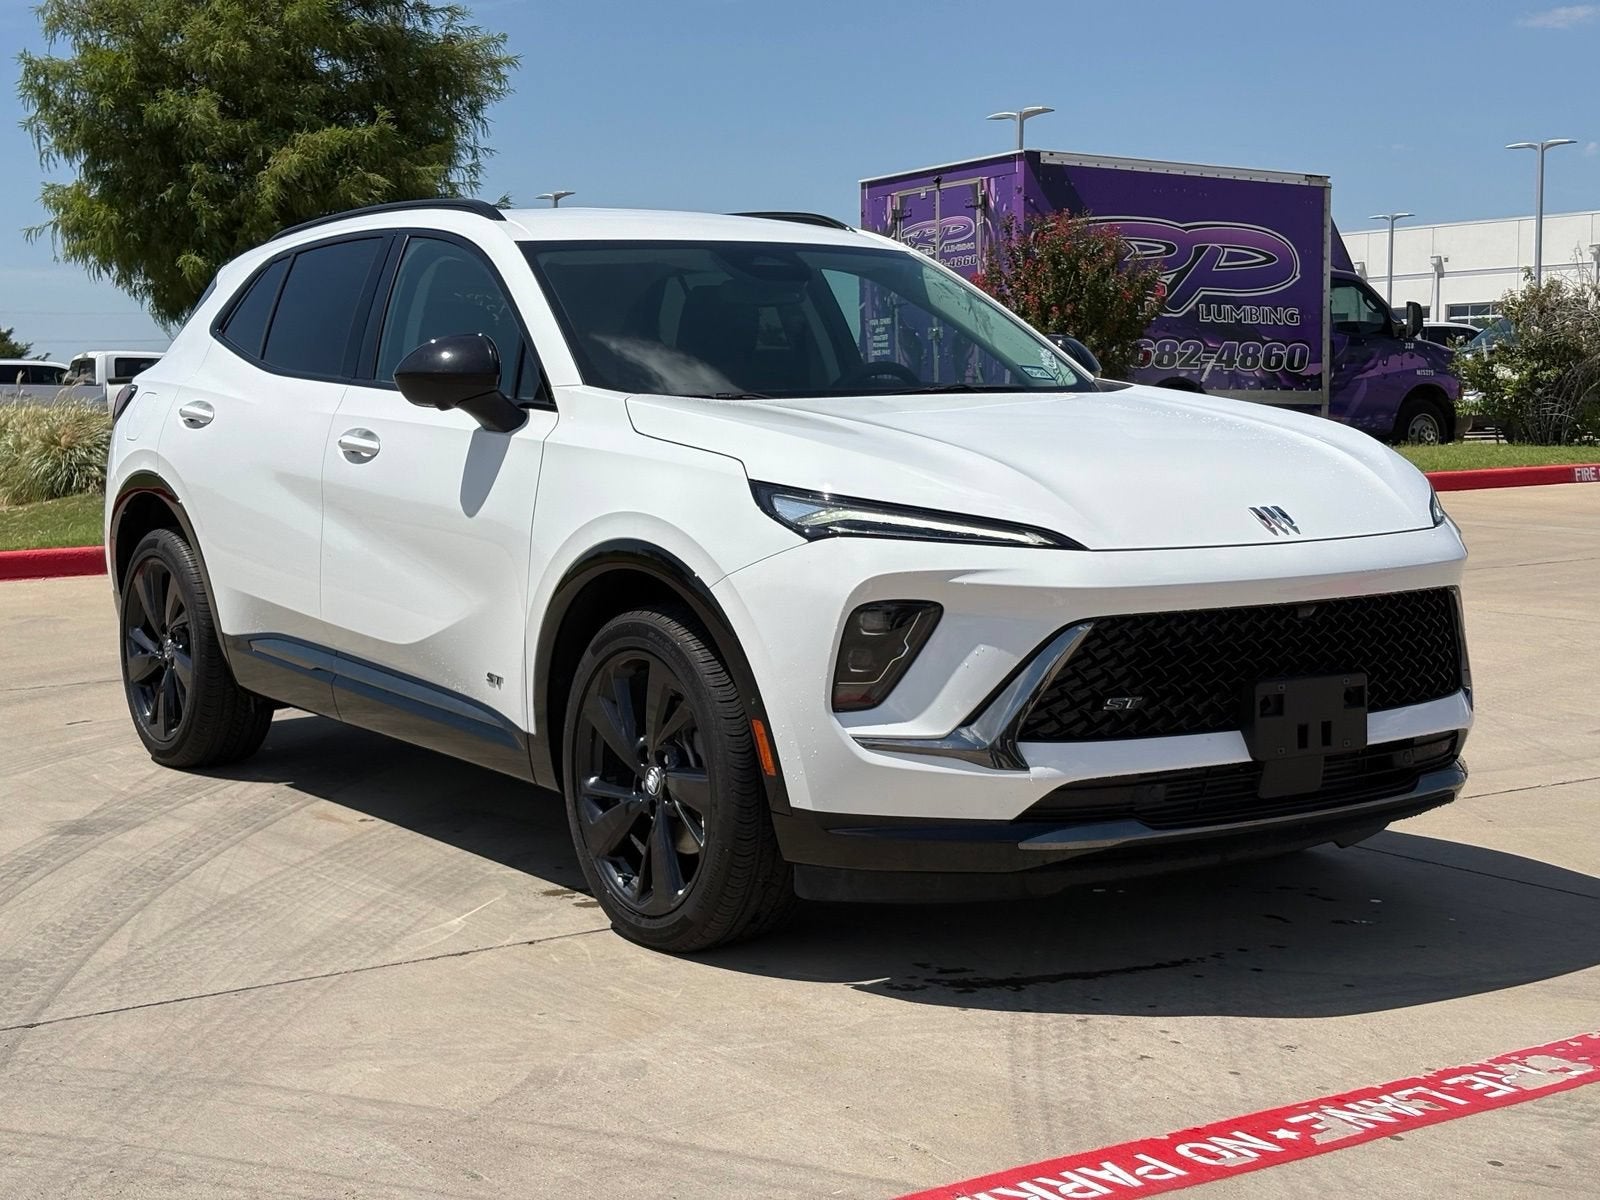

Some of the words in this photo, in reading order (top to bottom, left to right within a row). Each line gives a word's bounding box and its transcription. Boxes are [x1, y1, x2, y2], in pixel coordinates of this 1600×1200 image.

[1199, 303, 1300, 326] LUMBING
[1574, 466, 1598, 482] FIRE
[1103, 696, 1143, 710] ST
[1175, 1130, 1286, 1168] NO
[956, 1153, 1190, 1200] PARK
